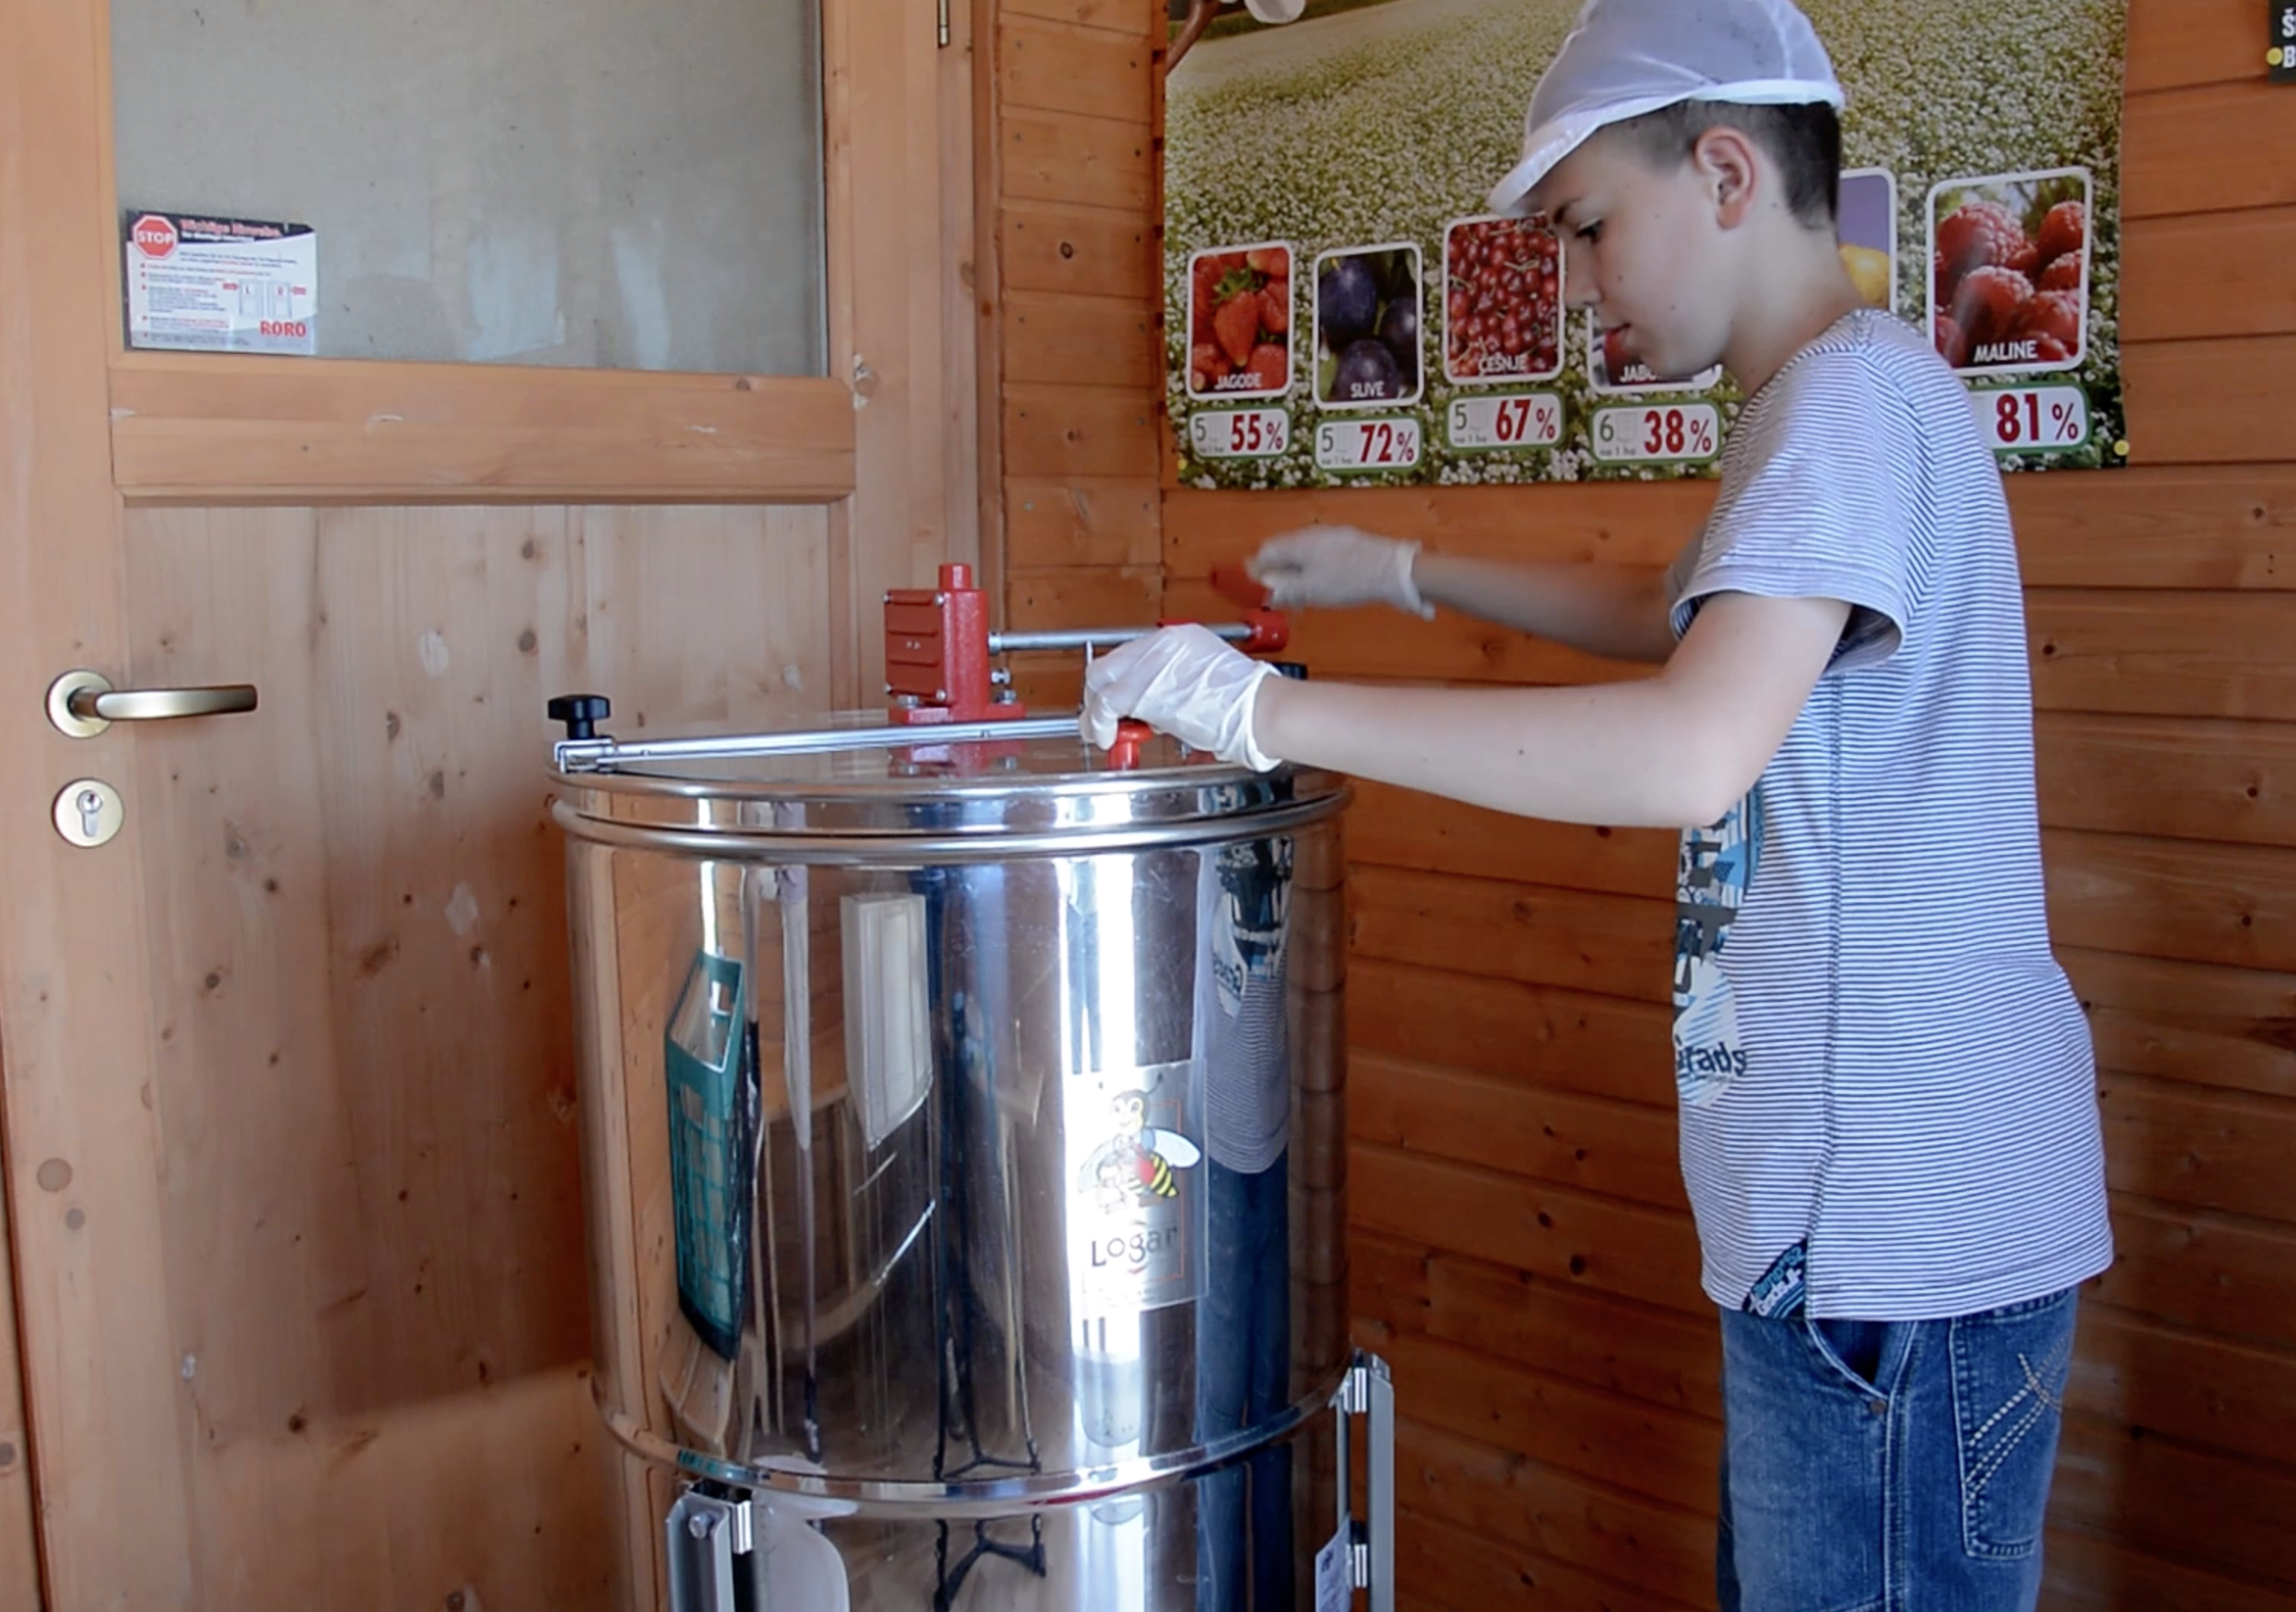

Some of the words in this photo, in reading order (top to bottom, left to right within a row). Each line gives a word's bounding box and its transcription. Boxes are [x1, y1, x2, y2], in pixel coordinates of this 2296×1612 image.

[138, 231, 175, 244] STOP
[259, 320, 307, 338] RORO
[1973, 339, 2038, 363] MALINE
[1214, 372, 1262, 390] JAGODE
[1350, 382, 1385, 398] SLIVE
[1455, 403, 1467, 431] 5
[1599, 414, 1614, 443] 6
[1194, 417, 1206, 442] 5
[1321, 427, 1334, 453] 5
[1091, 1226, 1179, 1268] Logar
